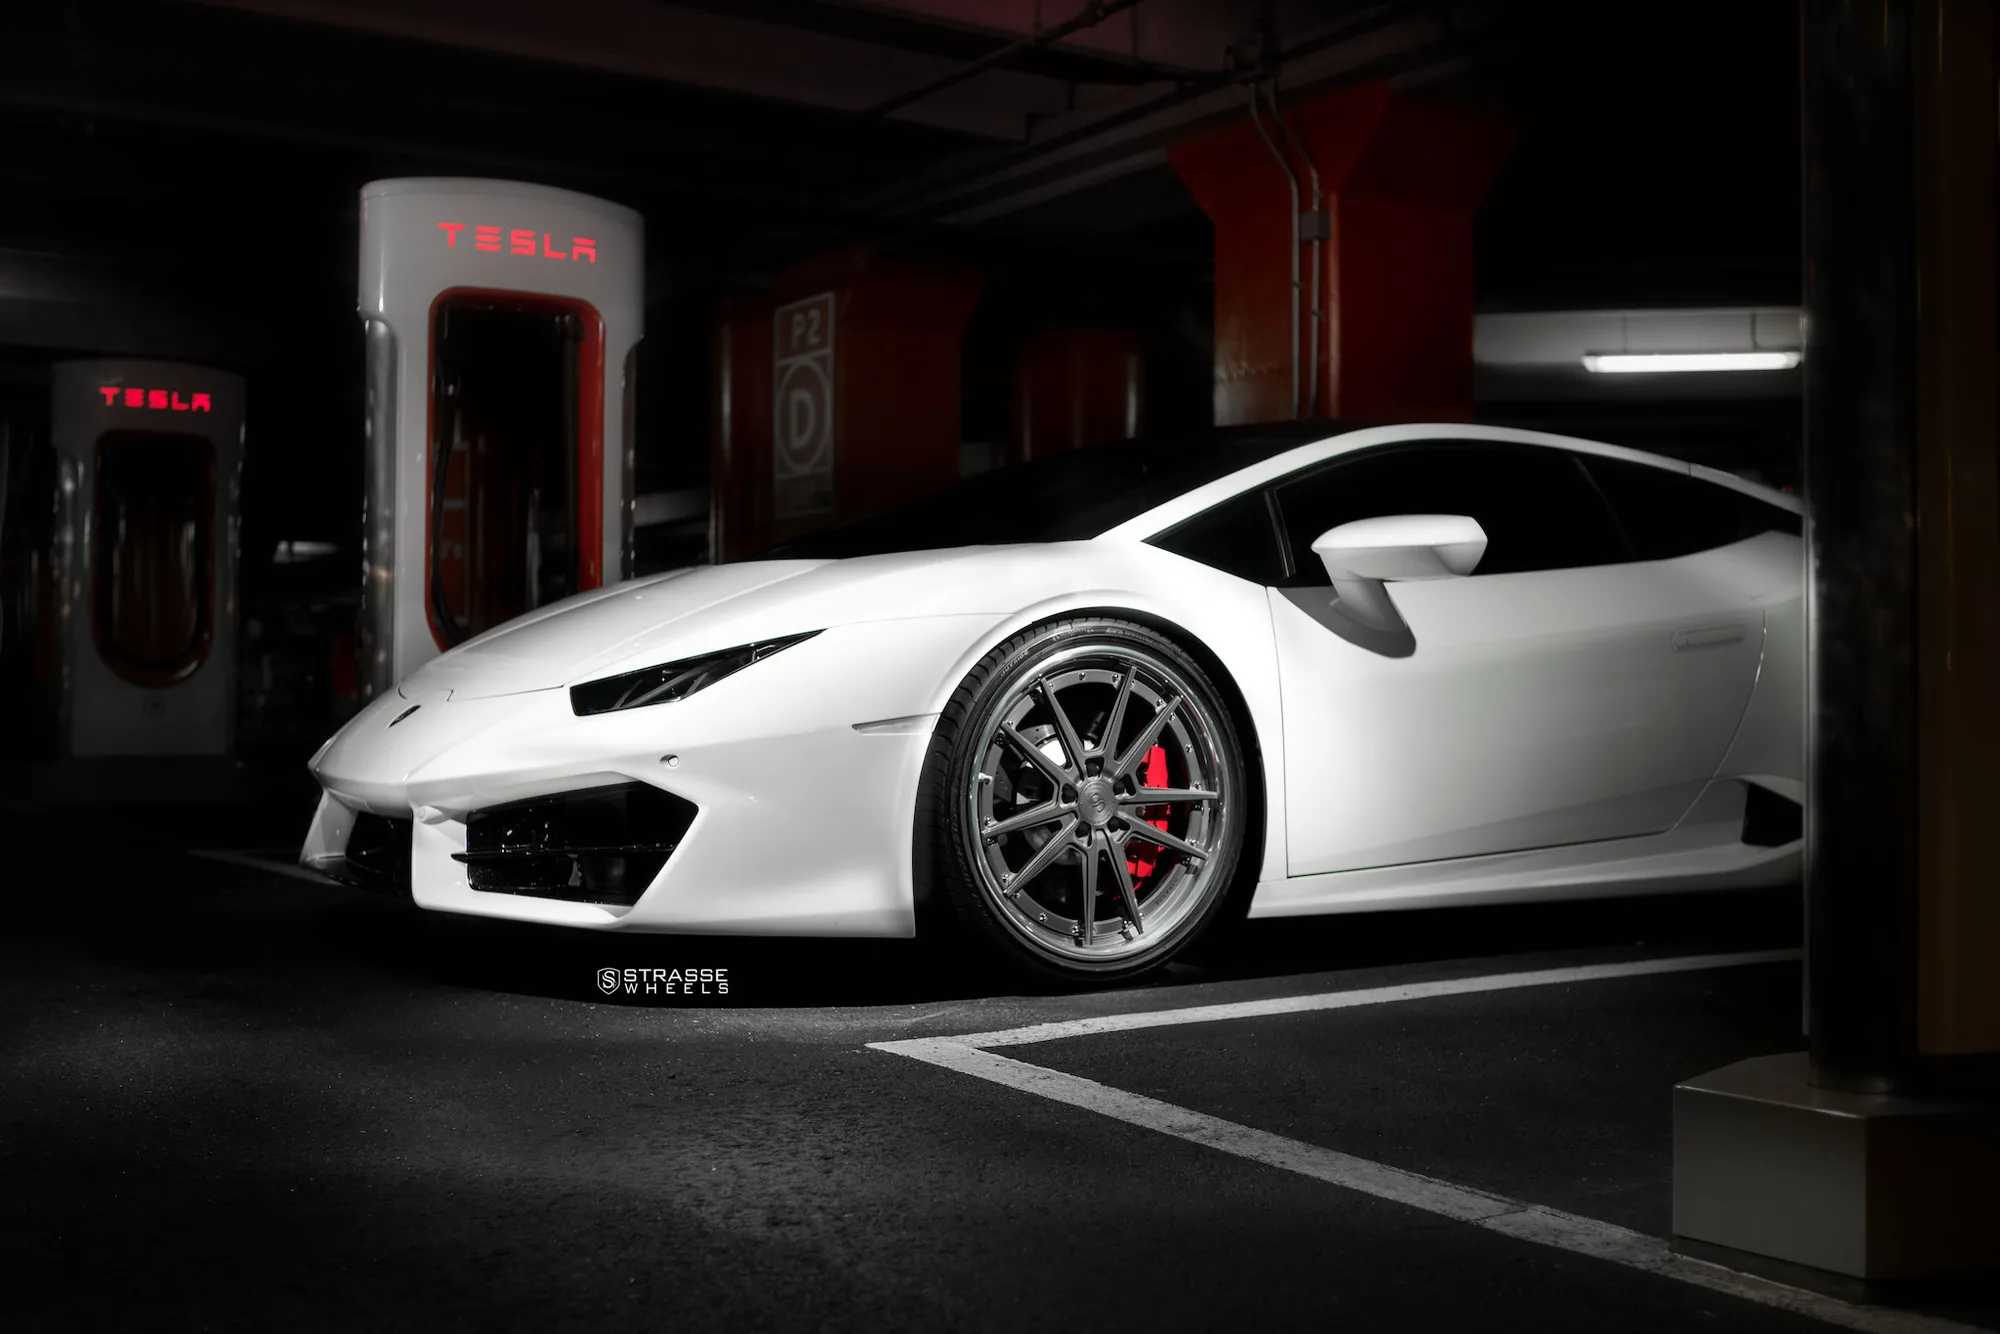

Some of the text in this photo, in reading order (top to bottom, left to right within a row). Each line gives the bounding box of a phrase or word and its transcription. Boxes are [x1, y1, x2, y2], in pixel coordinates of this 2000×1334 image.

[437, 222, 596, 264] TESLA
[791, 308, 822, 349] P2
[99, 386, 211, 413] TESLA
[789, 388, 816, 450] D
